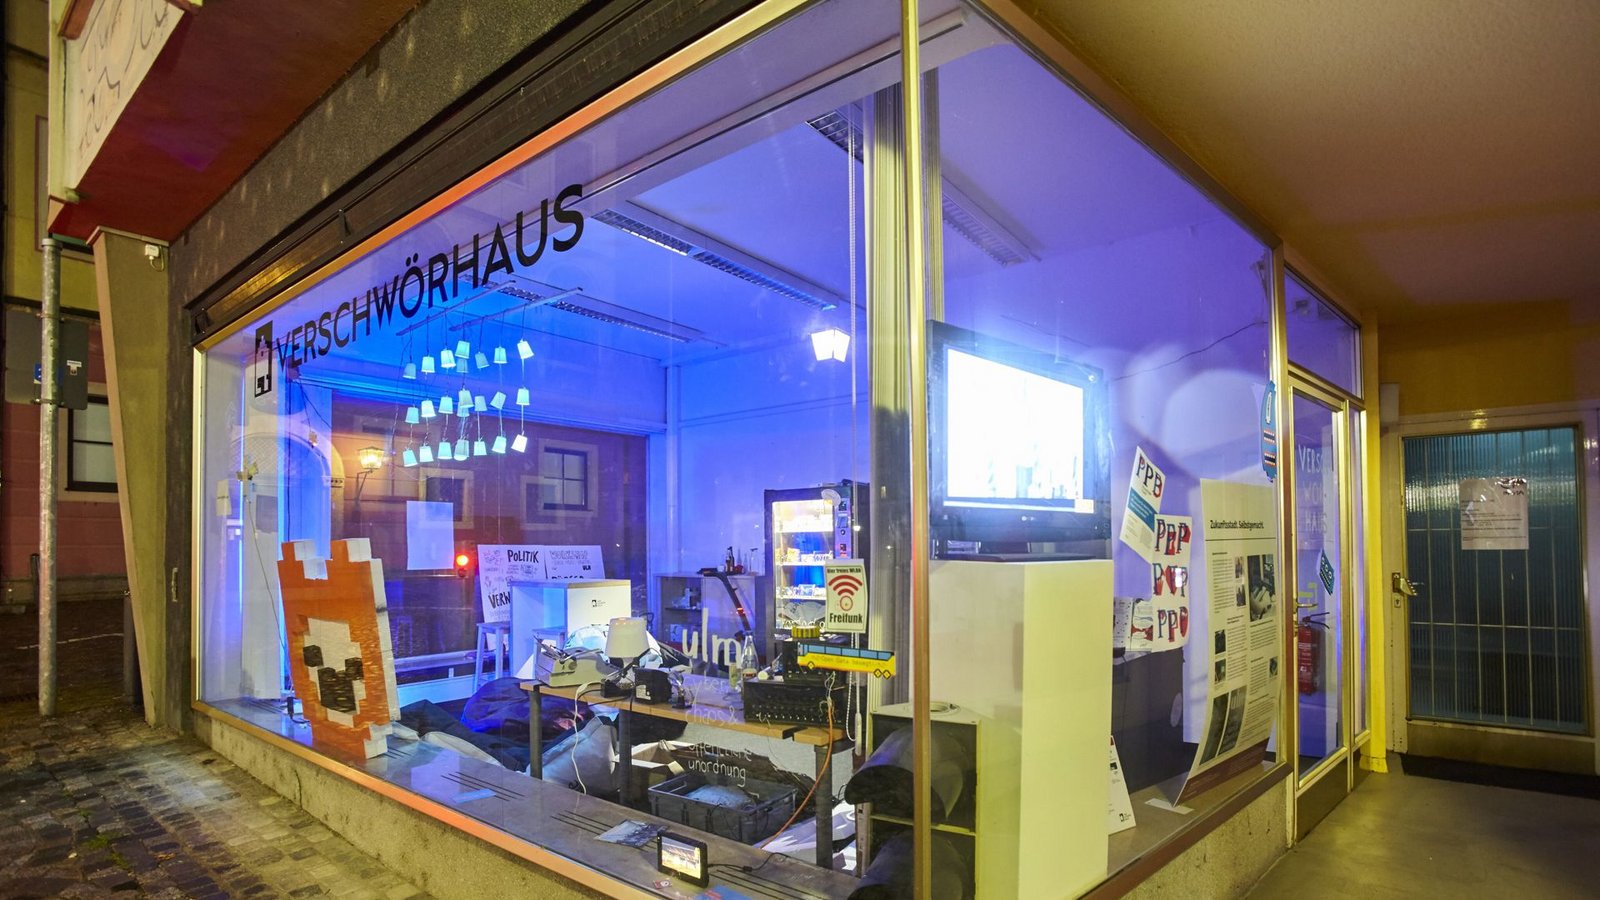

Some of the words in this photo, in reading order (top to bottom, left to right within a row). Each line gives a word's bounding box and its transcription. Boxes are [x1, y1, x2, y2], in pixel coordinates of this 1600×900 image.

[275, 183, 585, 373] VERSCHWÖRHAUS
[507, 549, 539, 564] POLITIK
[829, 613, 863, 624] Freifunk
[682, 607, 743, 670] ulm
[688, 757, 746, 788] unordnung
